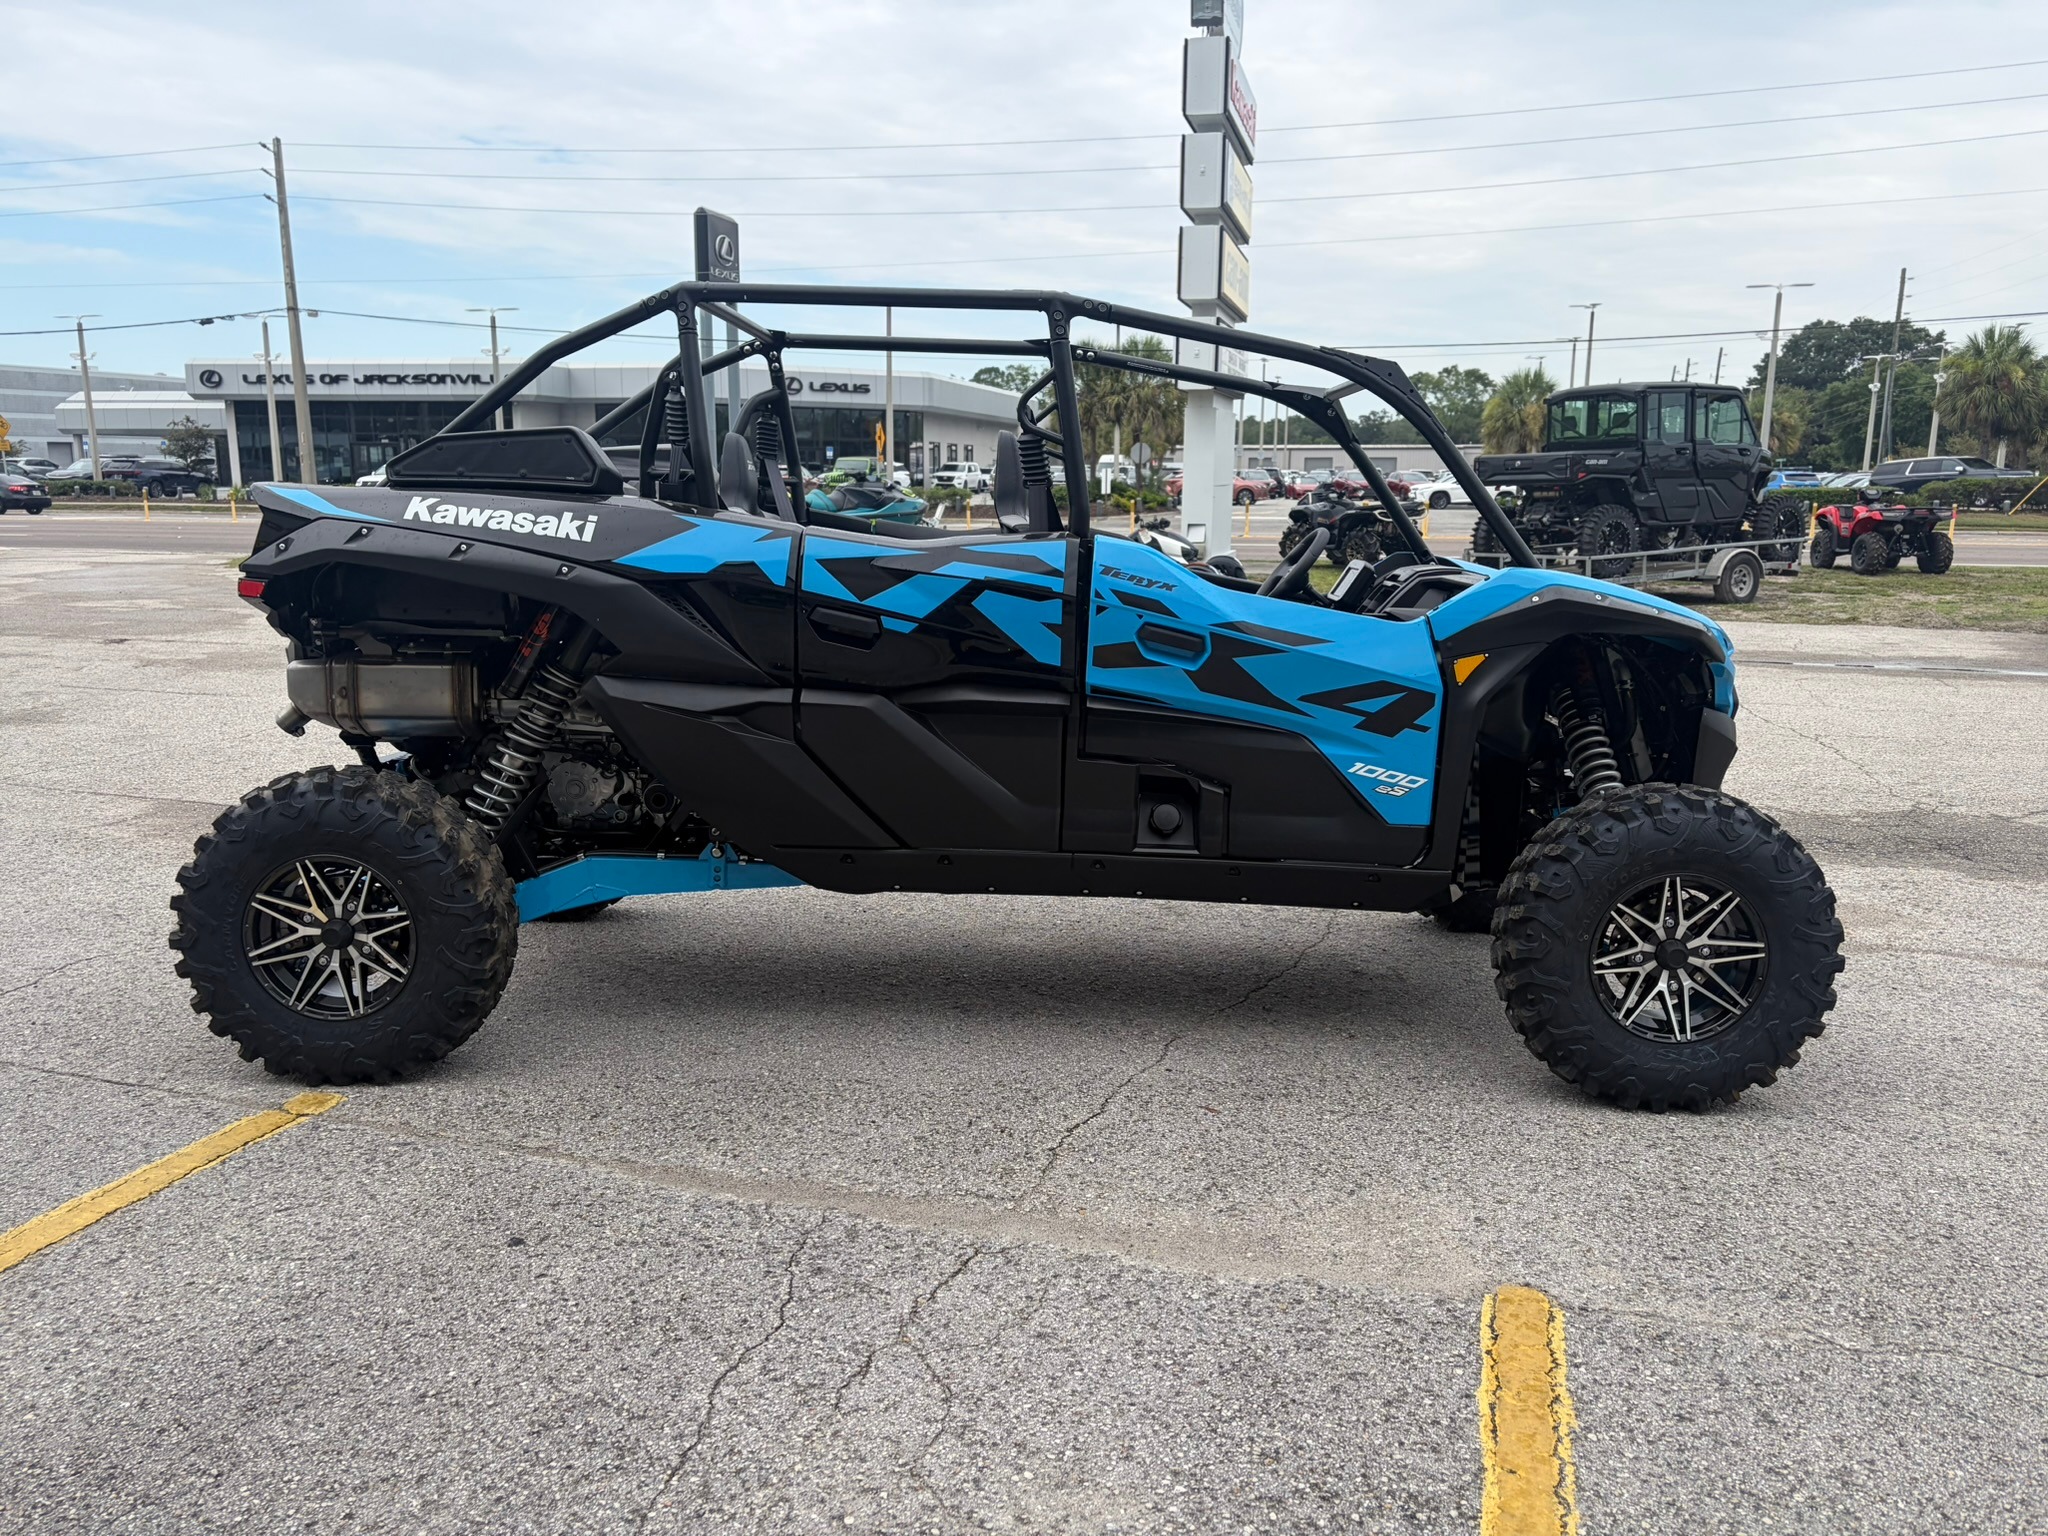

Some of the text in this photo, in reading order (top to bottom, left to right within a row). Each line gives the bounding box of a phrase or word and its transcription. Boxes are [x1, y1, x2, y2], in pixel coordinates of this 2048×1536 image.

[710, 266, 739, 282] LEXUS
[319, 373, 349, 386] OF
[809, 381, 871, 394] LEXUS
[402, 495, 598, 543] Kawasaki
[1347, 762, 1429, 789] 1000
